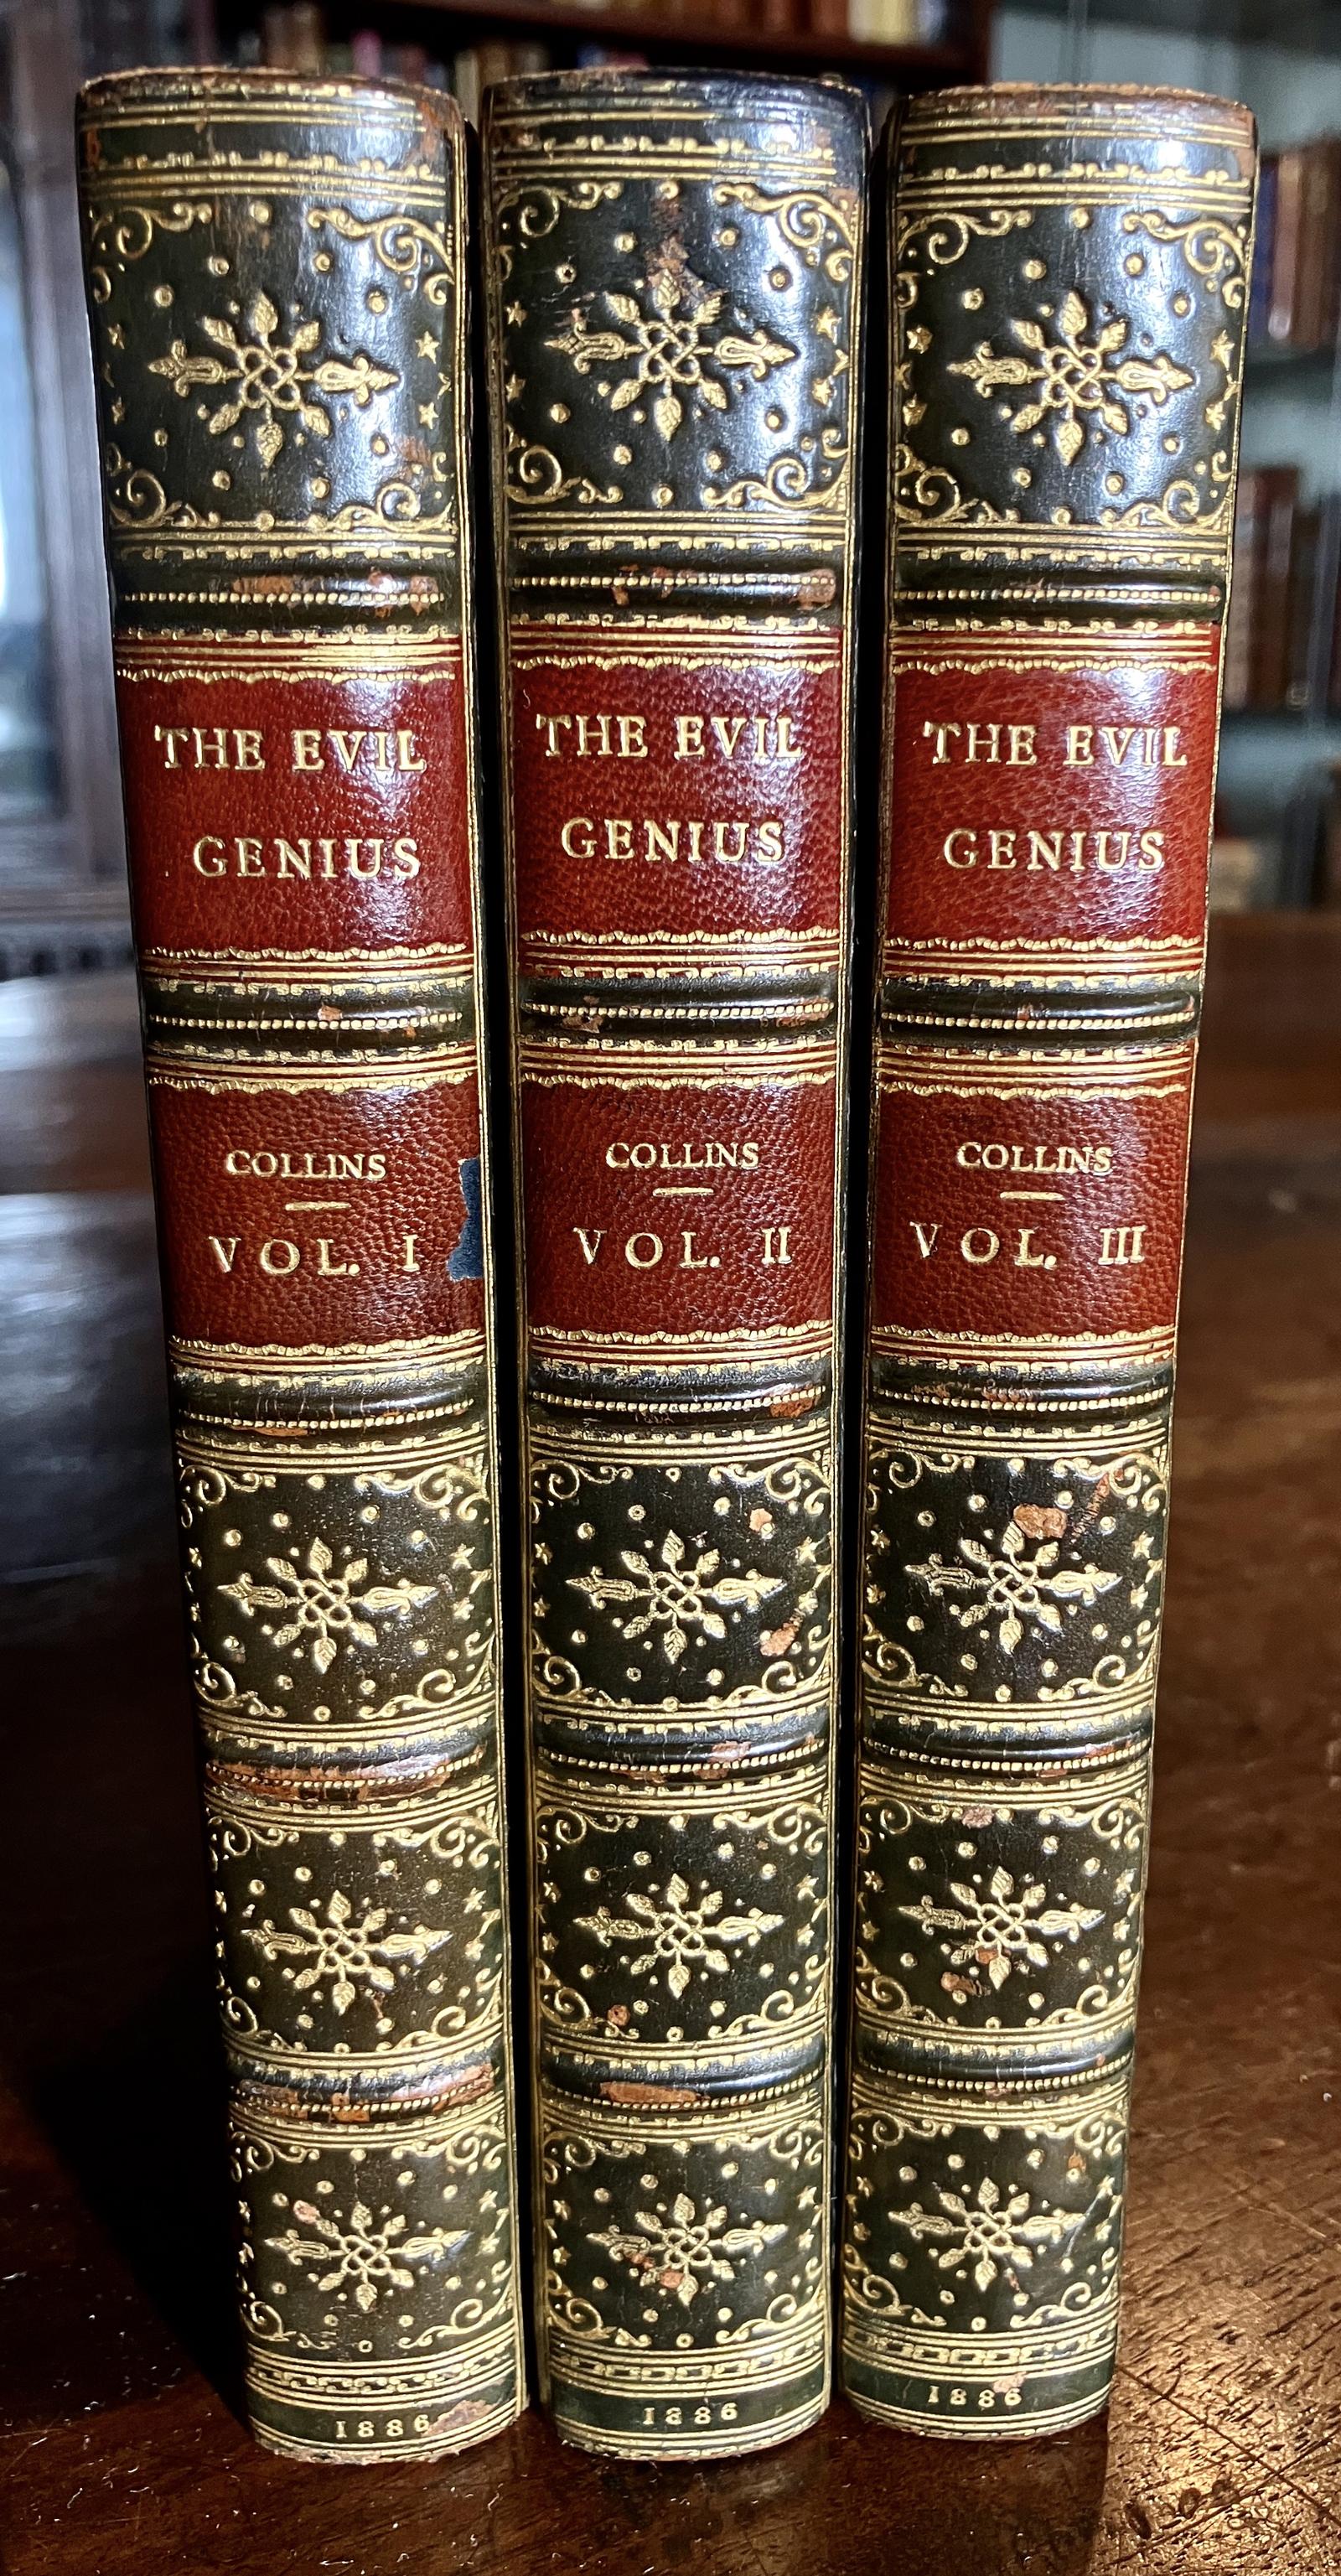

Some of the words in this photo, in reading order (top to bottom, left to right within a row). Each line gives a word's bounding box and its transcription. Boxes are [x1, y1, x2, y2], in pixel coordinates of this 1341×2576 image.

[154, 725, 265, 771] THE
[292, 729, 427, 771] EVIL
[536, 713, 648, 758] THE
[674, 715, 802, 759] EVIL
[923, 721, 1037, 765] THE
[1064, 725, 1188, 767] EVIL
[194, 837, 420, 879] GENIUS
[562, 816, 785, 863] GENIUS
[944, 828, 1165, 871] GENIUS
[226, 1150, 386, 1181] COLLINS
[606, 1142, 759, 1170] COLLINS
[957, 1142, 1113, 1175] COLLINS
[208, 1236, 360, 1276] VOL.
[402, 1234, 420, 1272] I
[573, 1226, 721, 1268] VOL.
[761, 1226, 792, 1265] II
[909, 1221, 1057, 1270] VOL.
[1098, 1225, 1147, 1265] III
[643, 2402, 738, 2425] 1886
[928, 2385, 1023, 2408] 1886
[335, 2414, 430, 2439] 1886
